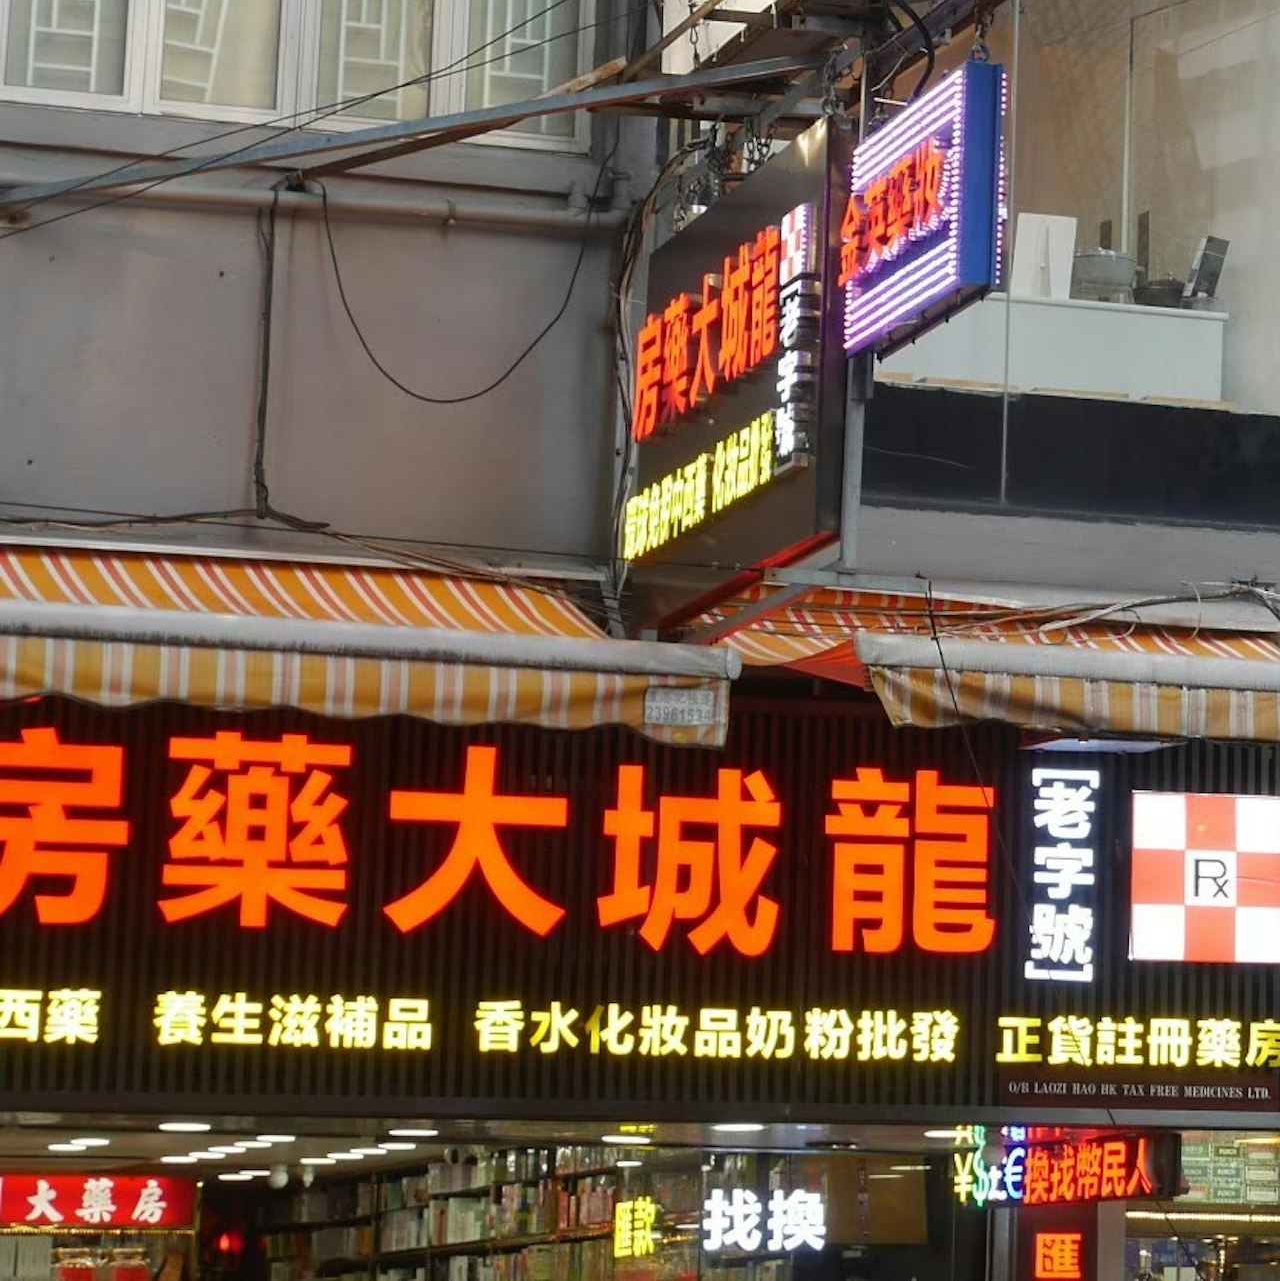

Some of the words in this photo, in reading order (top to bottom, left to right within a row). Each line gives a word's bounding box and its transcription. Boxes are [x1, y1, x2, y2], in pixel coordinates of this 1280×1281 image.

[153, 990, 435, 1051] 養生滋補品
[474, 1000, 959, 1063] 香水化妝品奶粉批發
[1034, 1081, 1067, 1095] LAOZI
[1072, 1082, 1097, 1096] HAO
[1122, 1084, 1145, 1097] TAX
[1150, 1085, 1179, 1098] FREE
[1183, 1086, 1243, 1099] MEDICINES
[1247, 1087, 1271, 1100] LTD.
[24, 1176, 168, 1224] 大藥房
[702, 1187, 828, 1252] 找換
